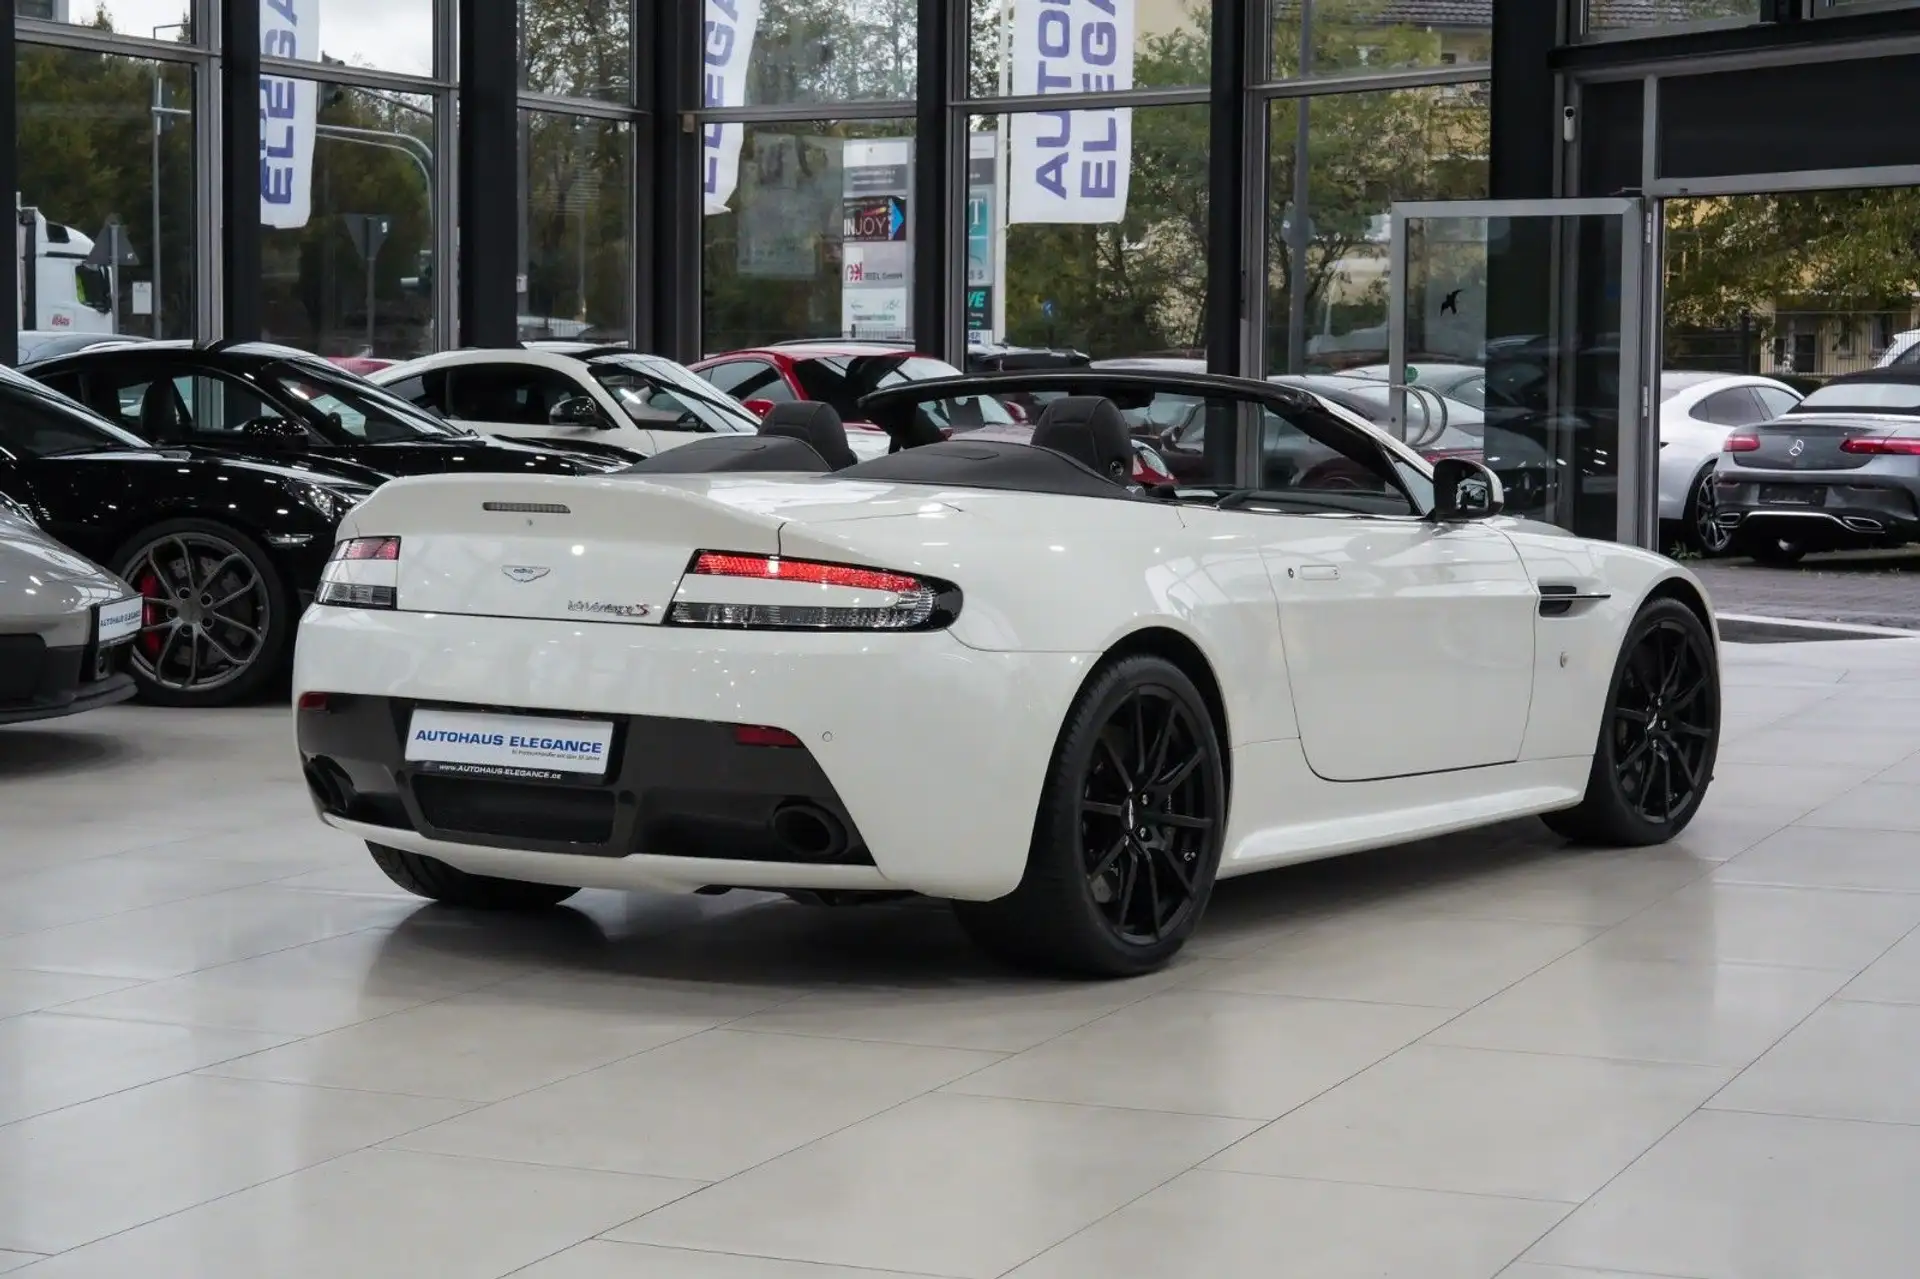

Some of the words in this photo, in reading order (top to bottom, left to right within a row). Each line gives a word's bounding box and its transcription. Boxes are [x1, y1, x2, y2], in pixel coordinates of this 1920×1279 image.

[1036, 0, 1072, 200] AUTO
[415, 729, 504, 746] AUTOHAUS
[509, 735, 603, 754] ELEGANCE
